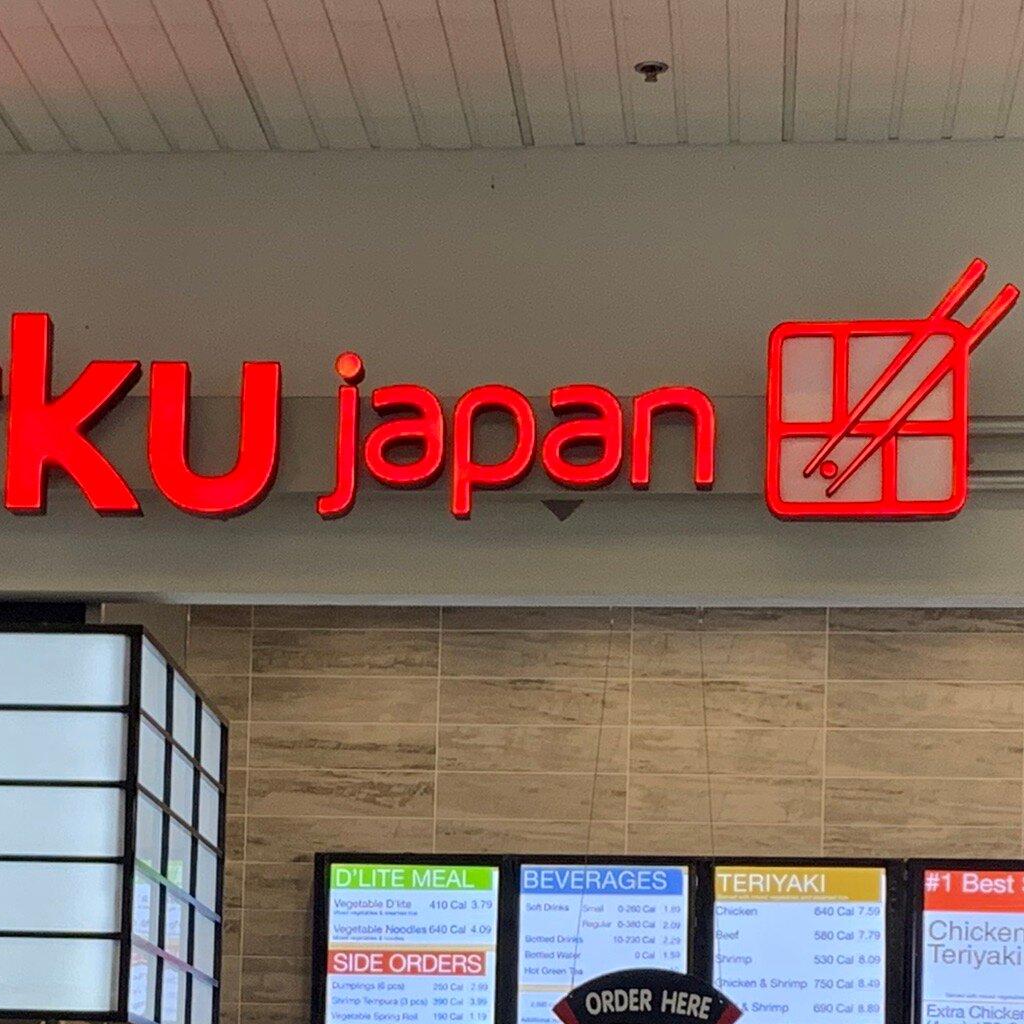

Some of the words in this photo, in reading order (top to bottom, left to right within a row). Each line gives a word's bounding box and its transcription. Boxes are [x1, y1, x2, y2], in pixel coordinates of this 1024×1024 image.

[318, 352, 719, 520] japan
[412, 869, 475, 889] MEAL
[524, 870, 668, 891] BEVERAGES
[717, 873, 826, 893] TERIYAKI
[925, 872, 951, 892] #1
[962, 873, 1014, 893] Best
[333, 899, 383, 910] Vegetable
[429, 900, 448, 910] 410
[450, 900, 467, 910] Cal
[471, 900, 493, 910] 3.79
[527, 902, 542, 911] Soft
[544, 903, 569, 912] Drinks
[582, 903, 604, 912] Small
[643, 904, 656, 913] Cal
[716, 906, 758, 916] Chicken
[837, 906, 854, 917] Cal
[859, 907, 880, 917] 7.59
[332, 924, 383, 935] Vegetable
[385, 924, 426, 935] Noodles
[428, 924, 447, 935] 640
[449, 924, 466, 934] Cal
[470, 925, 492, 935] 4.09
[582, 919, 611, 929] Regular
[643, 920, 656, 929] Cal
[525, 934, 555, 943] Bottled
[557, 934, 583, 944] Drinks
[643, 935, 656, 944] Cal
[716, 930, 739, 940] Beef
[814, 931, 834, 941] 580
[837, 931, 854, 941] Cal
[859, 931, 880, 941] 7.79
[525, 950, 554, 959] Bottled
[557, 950, 581, 959] Water
[642, 951, 656, 960] Cal
[716, 954, 752, 966] Shrimp
[814, 955, 833, 965] 530
[836, 955, 853, 965] Cal
[928, 943, 1021, 970] Teriyaki
[333, 952, 384, 973] SIDE
[388, 953, 482, 974] ORDERS
[524, 966, 539, 975] Hot
[542, 966, 567, 976] Green
[331, 982, 375, 993] Dumplings
[387, 982, 405, 992] pcs)
[450, 982, 464, 991] Cal
[715, 978, 757, 988] Chicken
[760, 979, 767, 988] &
[770, 978, 807, 990] Shrimp
[814, 979, 832, 989] 750
[836, 979, 853, 989] Cal
[331, 996, 360, 1006] Shrimp
[363, 996, 398, 1007] Tempura
[410, 997, 428, 1008] pcs)
[450, 997, 464, 1006] Cal
[585, 988, 652, 1015] ORDER
[661, 990, 713, 1020] HERE
[751, 1002, 788, 1014] Shrimp
[836, 1003, 853, 1013] Cal
[331, 1012, 372, 1022] Vegetable
[374, 1012, 400, 1022] Spring
[402, 1012, 418, 1021] Roll
[450, 1012, 464, 1021] Cal
[927, 1004, 965, 1018] Extra
